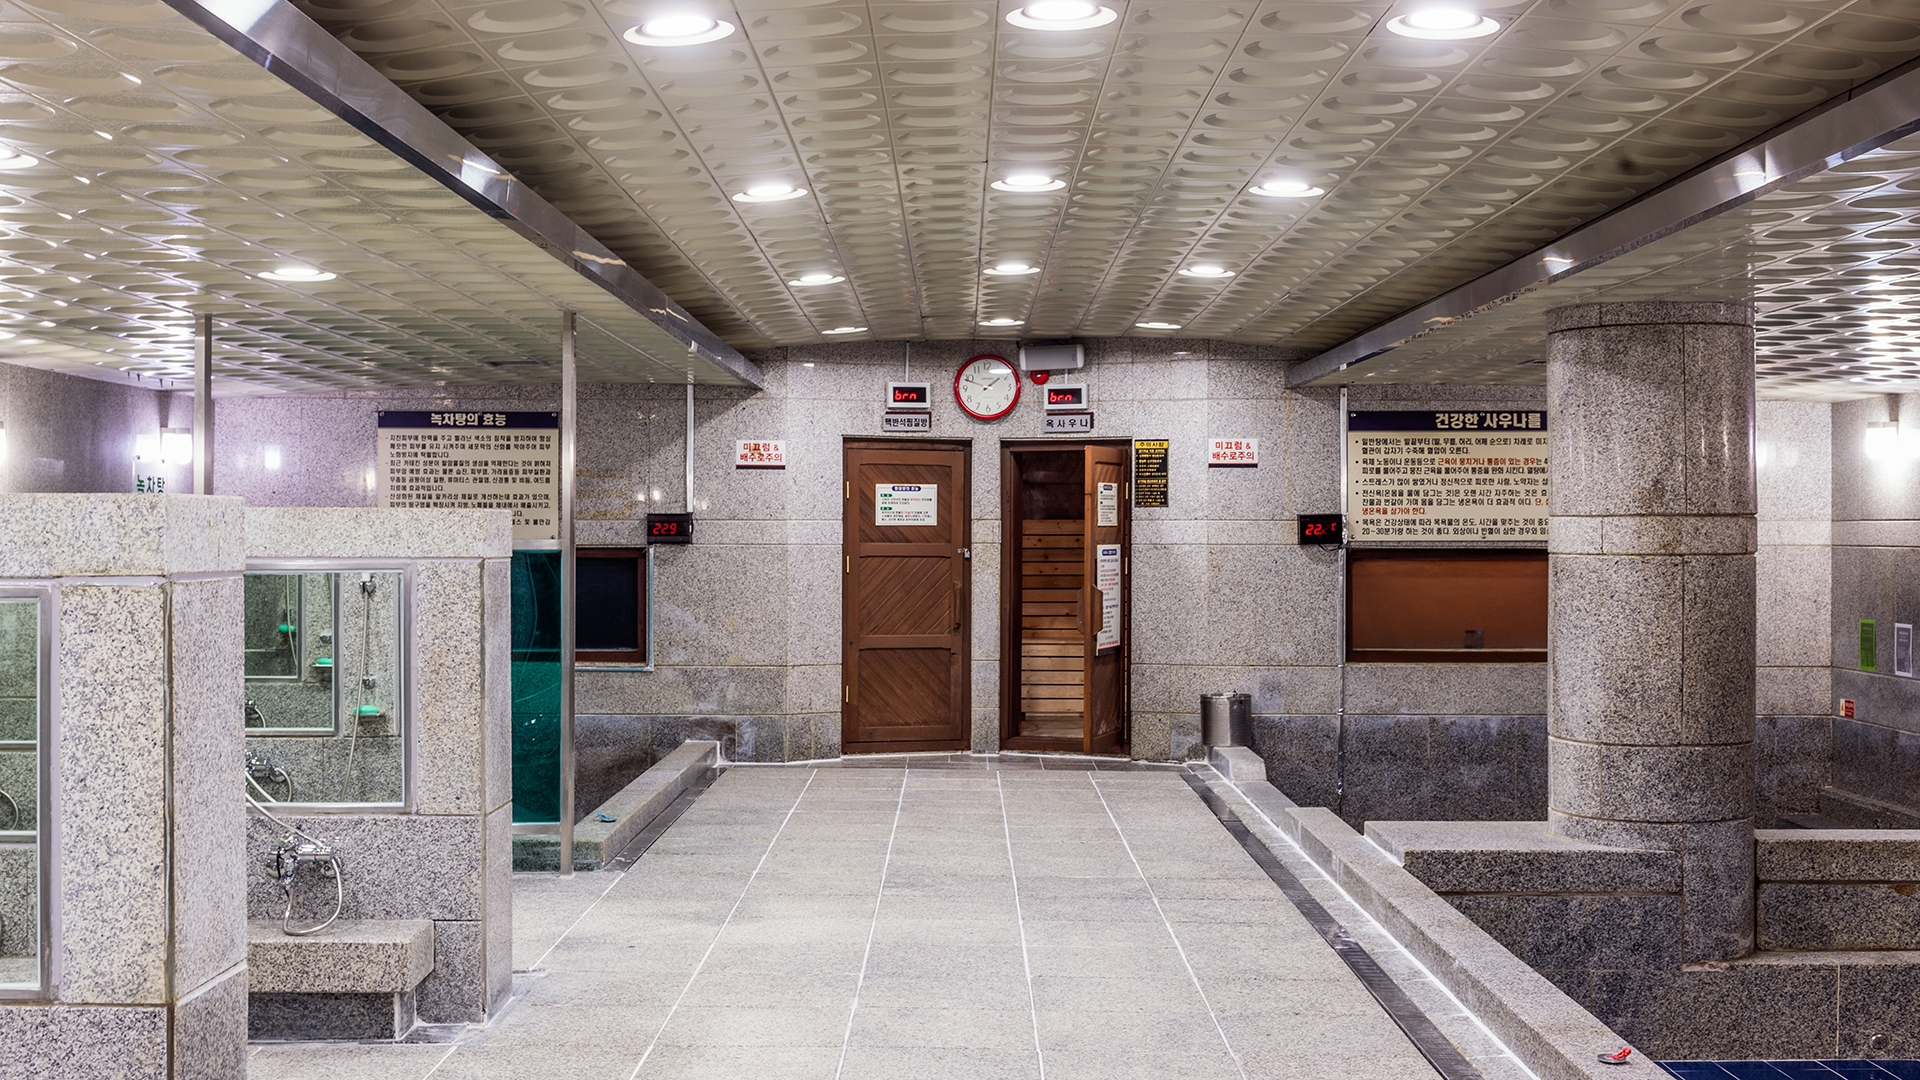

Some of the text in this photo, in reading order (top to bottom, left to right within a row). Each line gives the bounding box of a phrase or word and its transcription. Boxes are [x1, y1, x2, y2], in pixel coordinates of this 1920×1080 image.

[984, 362, 991, 370] 12
[431, 413, 506, 426] 녹차탕의 효능
[1436, 413, 1541, 428] 건강한 사우나를
[743, 443, 770, 451] 미끄럼
[1216, 441, 1242, 450] 미끄럼
[740, 453, 782, 462] 배수로주의
[1212, 451, 1254, 460] 배수로주의
[137, 474, 165, 493] 녹차탕
